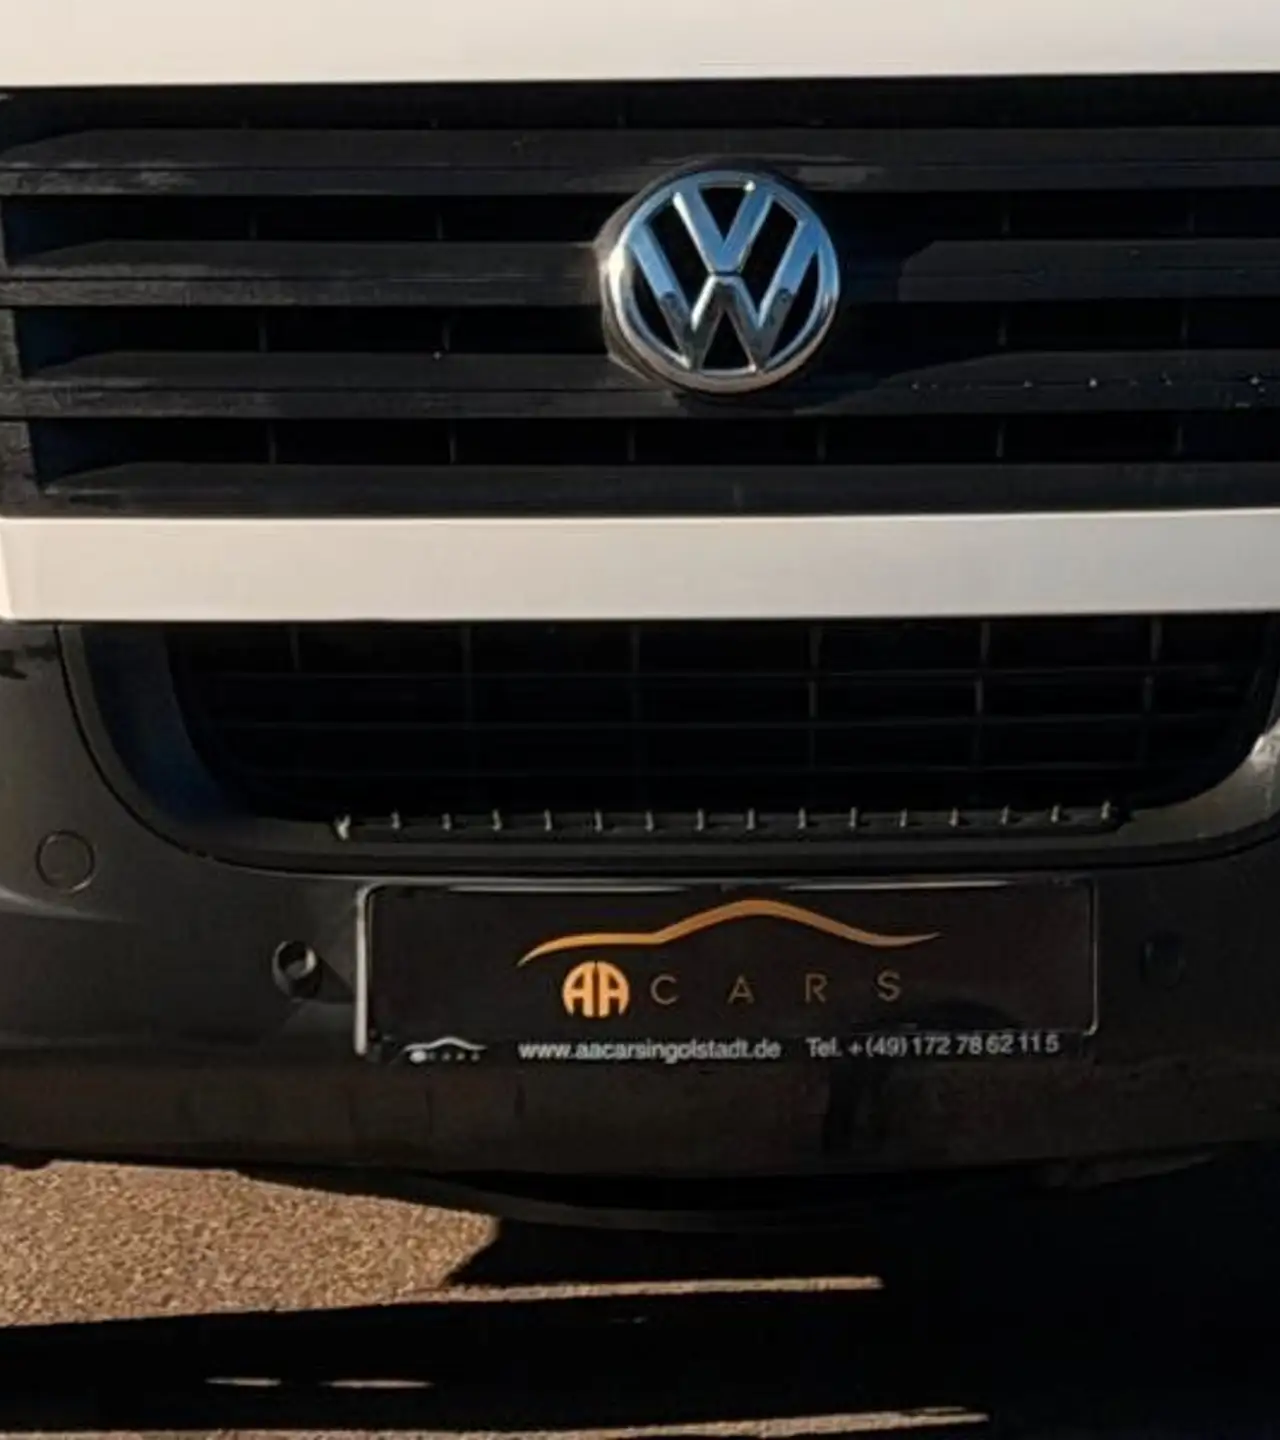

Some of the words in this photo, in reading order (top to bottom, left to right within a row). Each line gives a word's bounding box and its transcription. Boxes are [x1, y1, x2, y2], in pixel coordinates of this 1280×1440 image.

[624, 174, 824, 375] VW
[562, 961, 631, 1018] AA
[650, 970, 902, 1005] CARS
[518, 1037, 782, 1064] www.aacarsingolstadt.de
